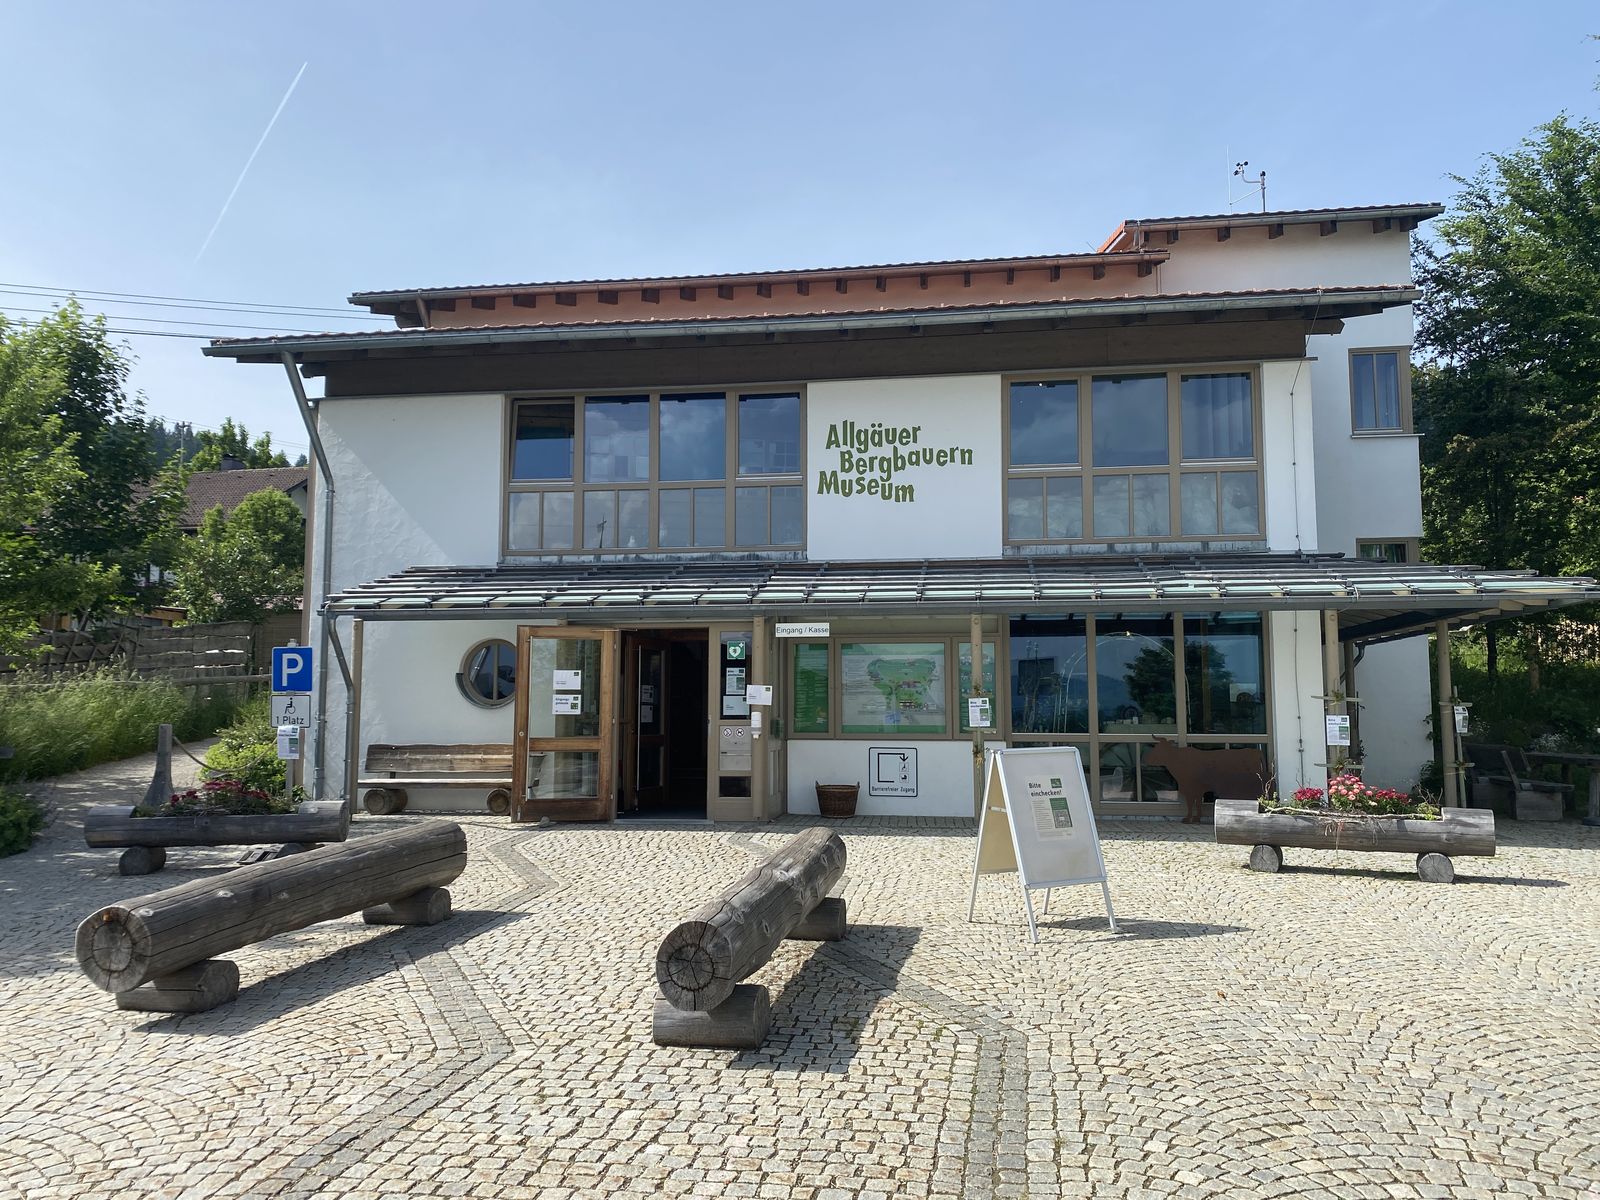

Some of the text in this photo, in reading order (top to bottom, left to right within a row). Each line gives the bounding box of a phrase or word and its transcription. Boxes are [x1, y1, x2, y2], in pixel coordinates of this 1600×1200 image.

[825, 419, 921, 454] Allgäuer
[840, 445, 973, 482] Bergbauern
[817, 470, 914, 503] Museum
[776, 626, 803, 635] Eingang
[281, 653, 304, 687] P
[276, 716, 304, 725] 1 Platz
[1031, 789, 1062, 797] einchecken!
